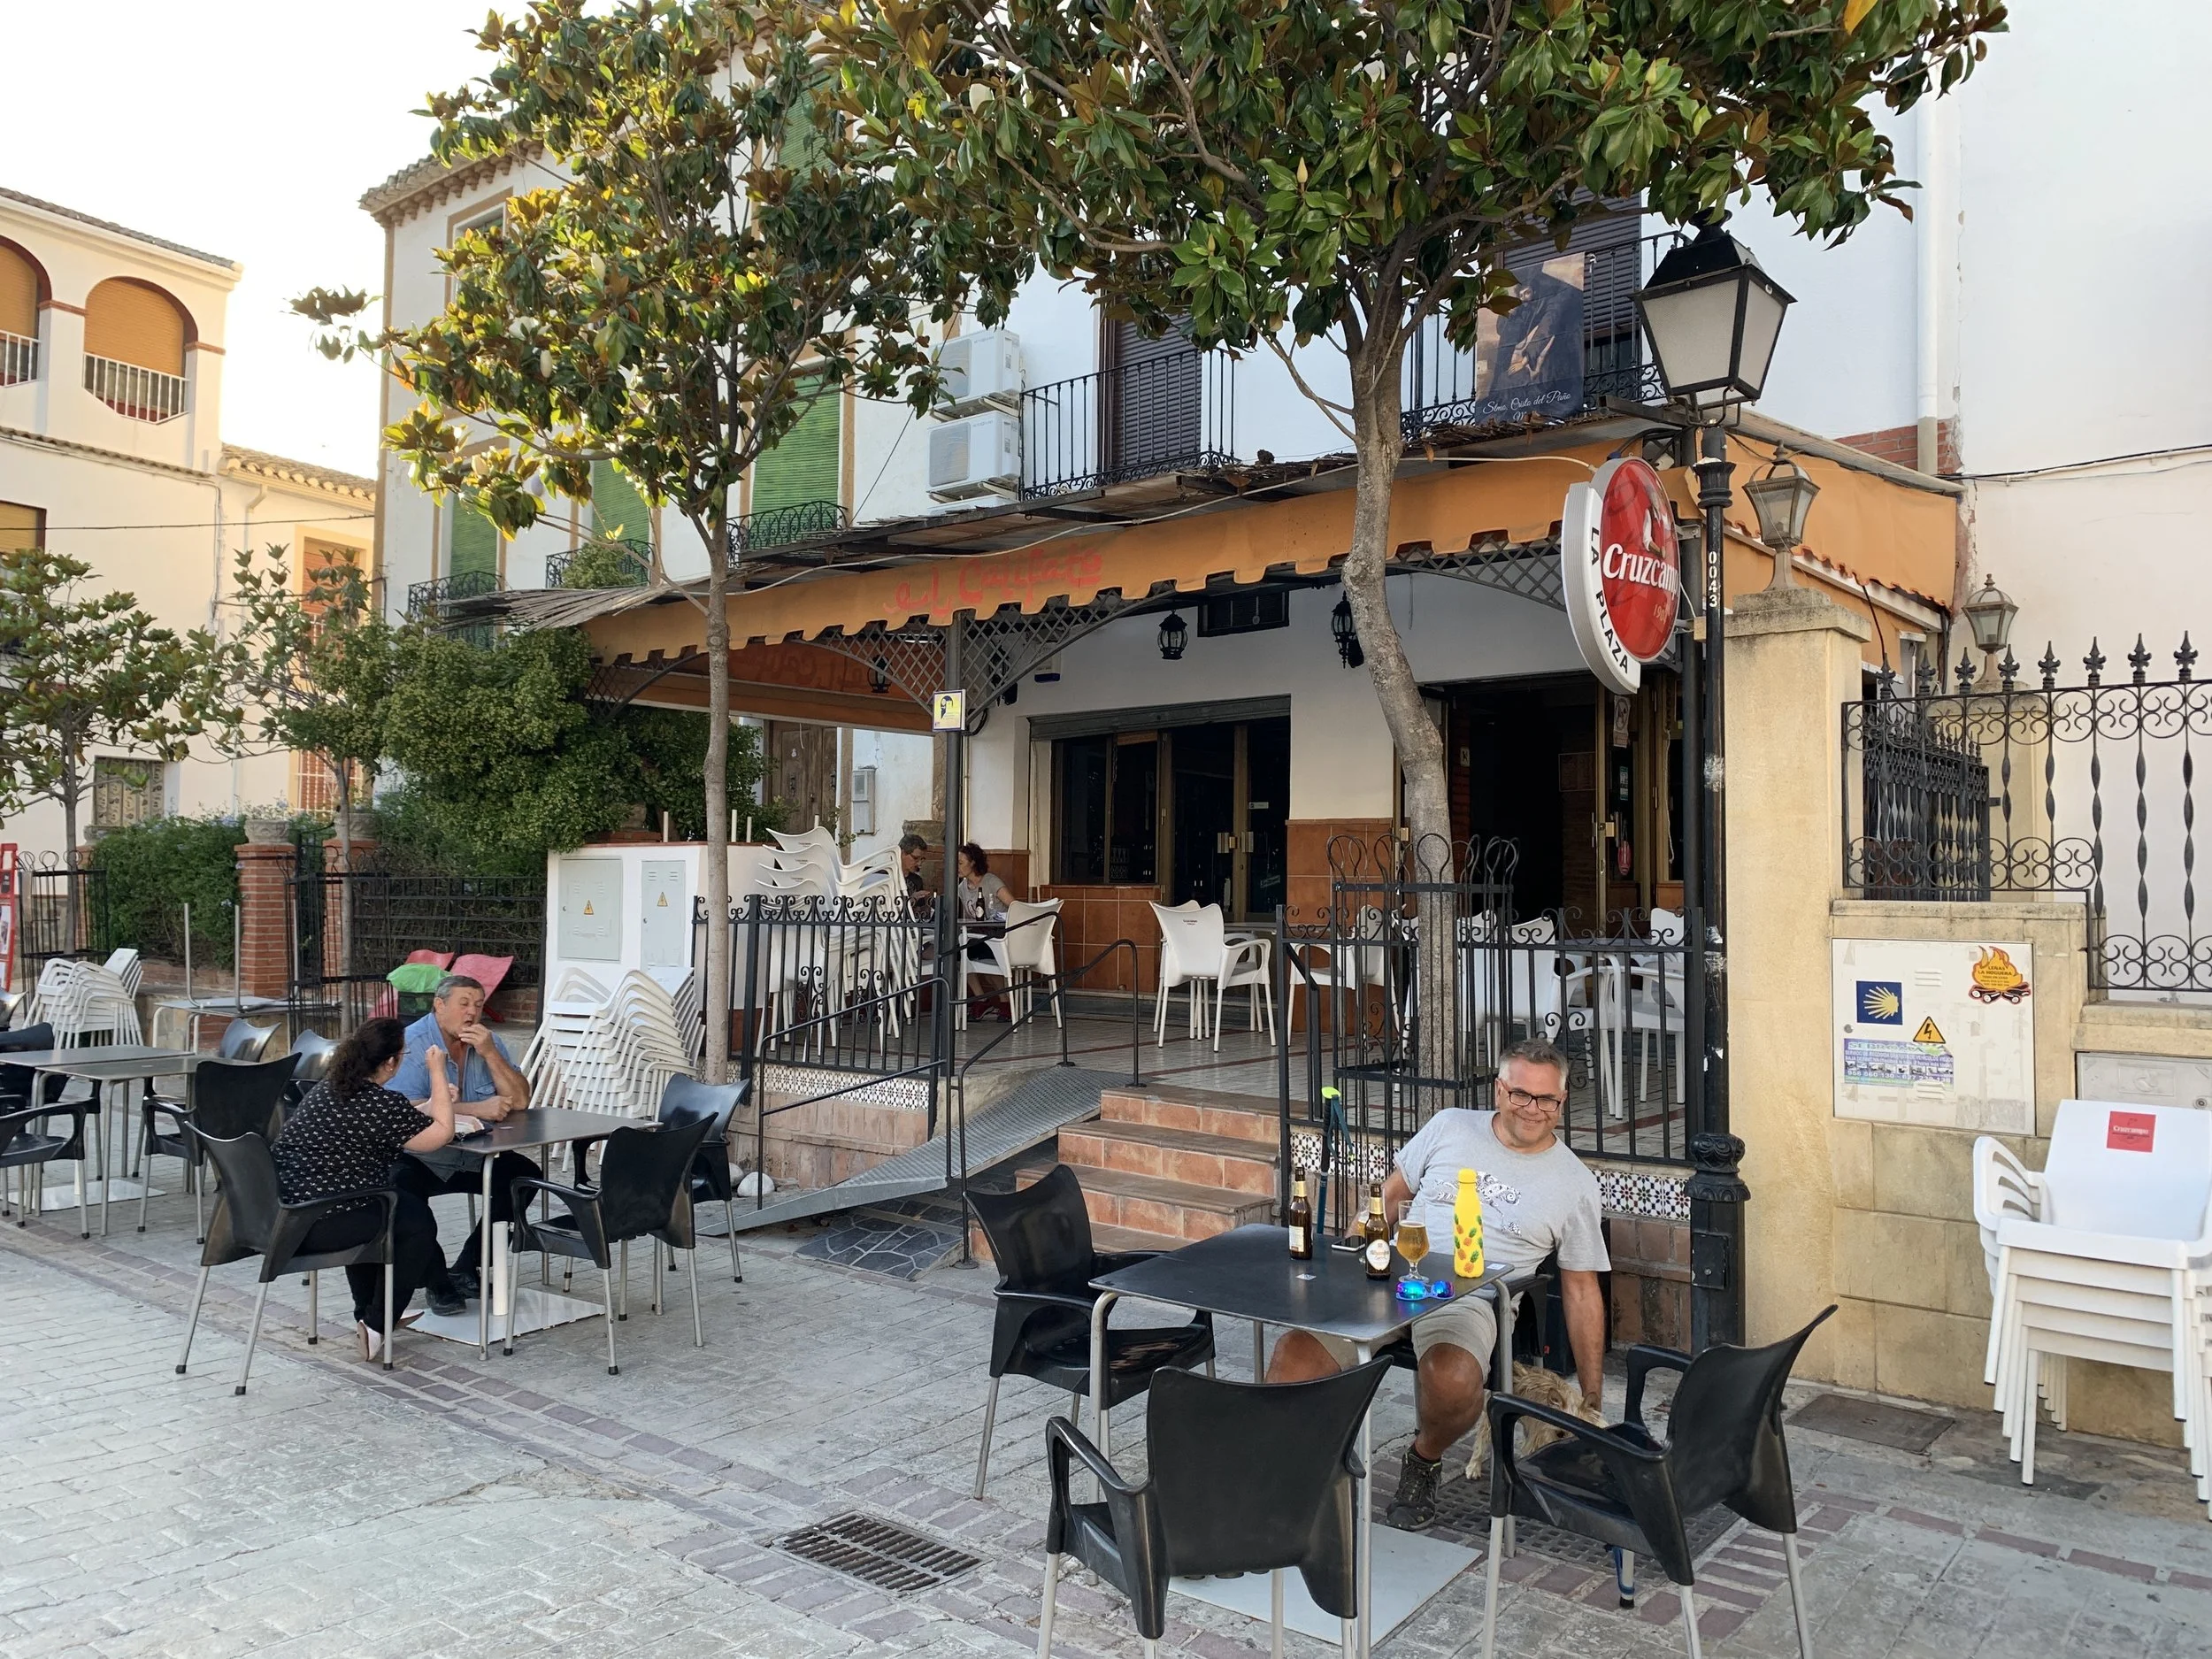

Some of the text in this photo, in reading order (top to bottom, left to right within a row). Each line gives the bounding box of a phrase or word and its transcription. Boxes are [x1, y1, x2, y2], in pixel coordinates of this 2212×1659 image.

[1533, 394, 1546, 405] del
[1591, 526, 1629, 674] LA PLAZA
[1602, 542, 1678, 601] Cruzcamp
